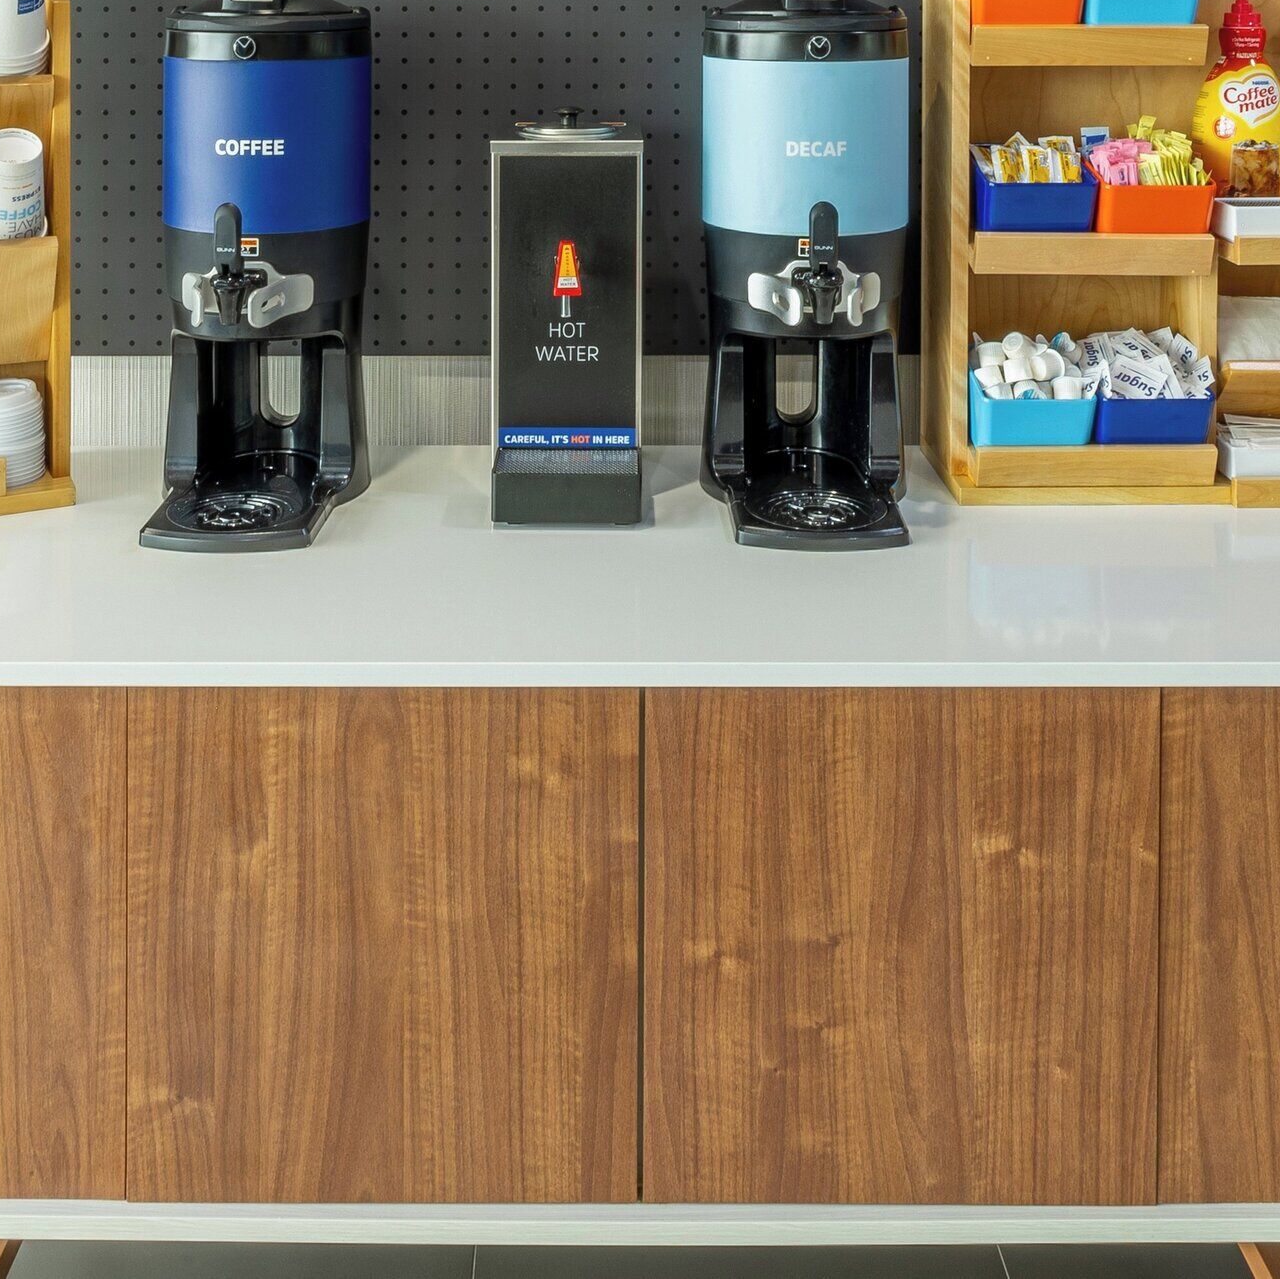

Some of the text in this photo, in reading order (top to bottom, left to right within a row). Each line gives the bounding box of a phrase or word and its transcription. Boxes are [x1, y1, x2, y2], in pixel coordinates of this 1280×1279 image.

[1224, 85, 1275, 104] Coffee
[1239, 95, 1278, 113] mate
[214, 139, 285, 156] COFFEE
[785, 141, 847, 157] DECAF
[549, 322, 586, 338] HOT
[535, 346, 599, 362] WATER
[1083, 341, 1099, 367] Sugar
[1114, 371, 1157, 397] Sugar
[504, 435, 630, 445] CAREFUL, IT'S HOT IN HERE
